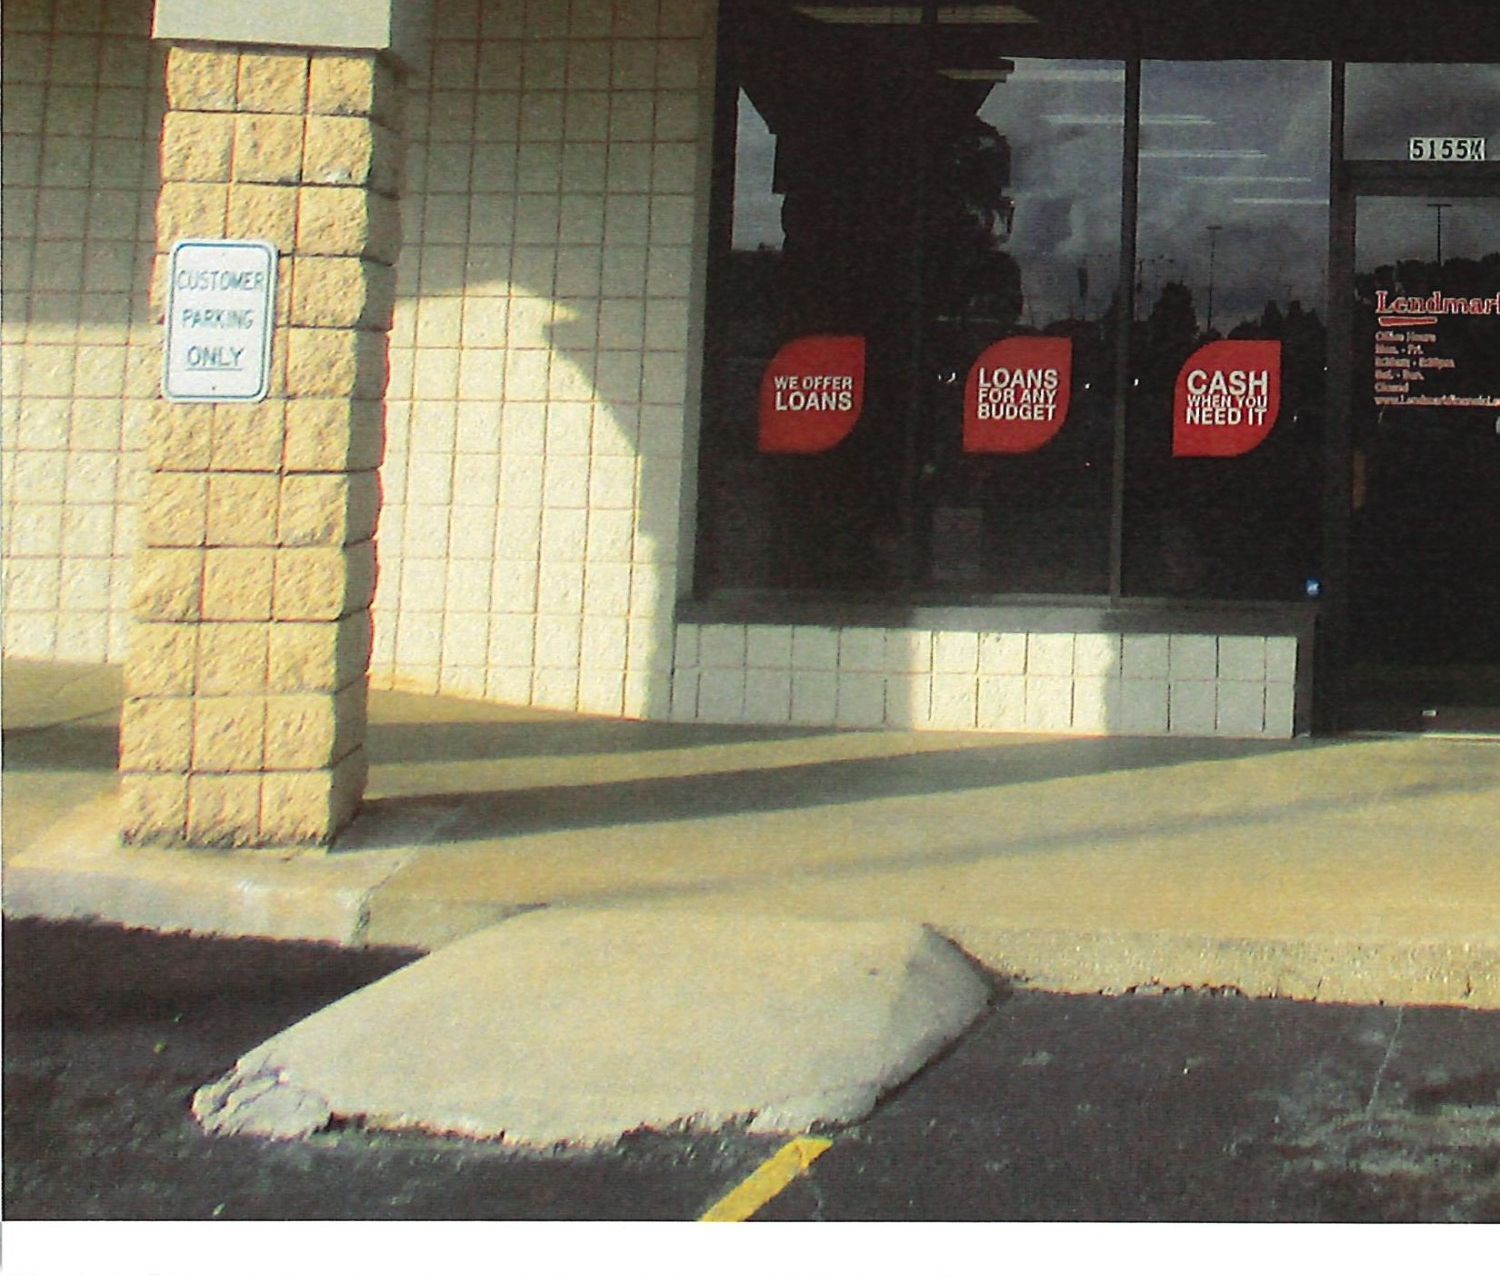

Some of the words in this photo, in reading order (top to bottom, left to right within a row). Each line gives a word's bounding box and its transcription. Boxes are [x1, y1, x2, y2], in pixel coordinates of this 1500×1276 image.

[176, 269, 265, 292] CUSTOMER
[181, 308, 255, 330] PARKING
[186, 345, 245, 368] ONLY
[774, 376, 799, 390] WE
[802, 376, 853, 390] OFFER
[979, 367, 1058, 389] LOANS
[1187, 369, 1268, 396] CASH
[775, 391, 852, 411] LOANS
[979, 388, 1015, 403] FOR
[1020, 388, 1057, 404] ANY
[1187, 393, 1232, 408] WHEN
[1235, 395, 1267, 408] YOU
[978, 403, 1057, 421] BUDGET
[1186, 406, 1242, 425] NEED
[1248, 407, 1267, 426] IT
